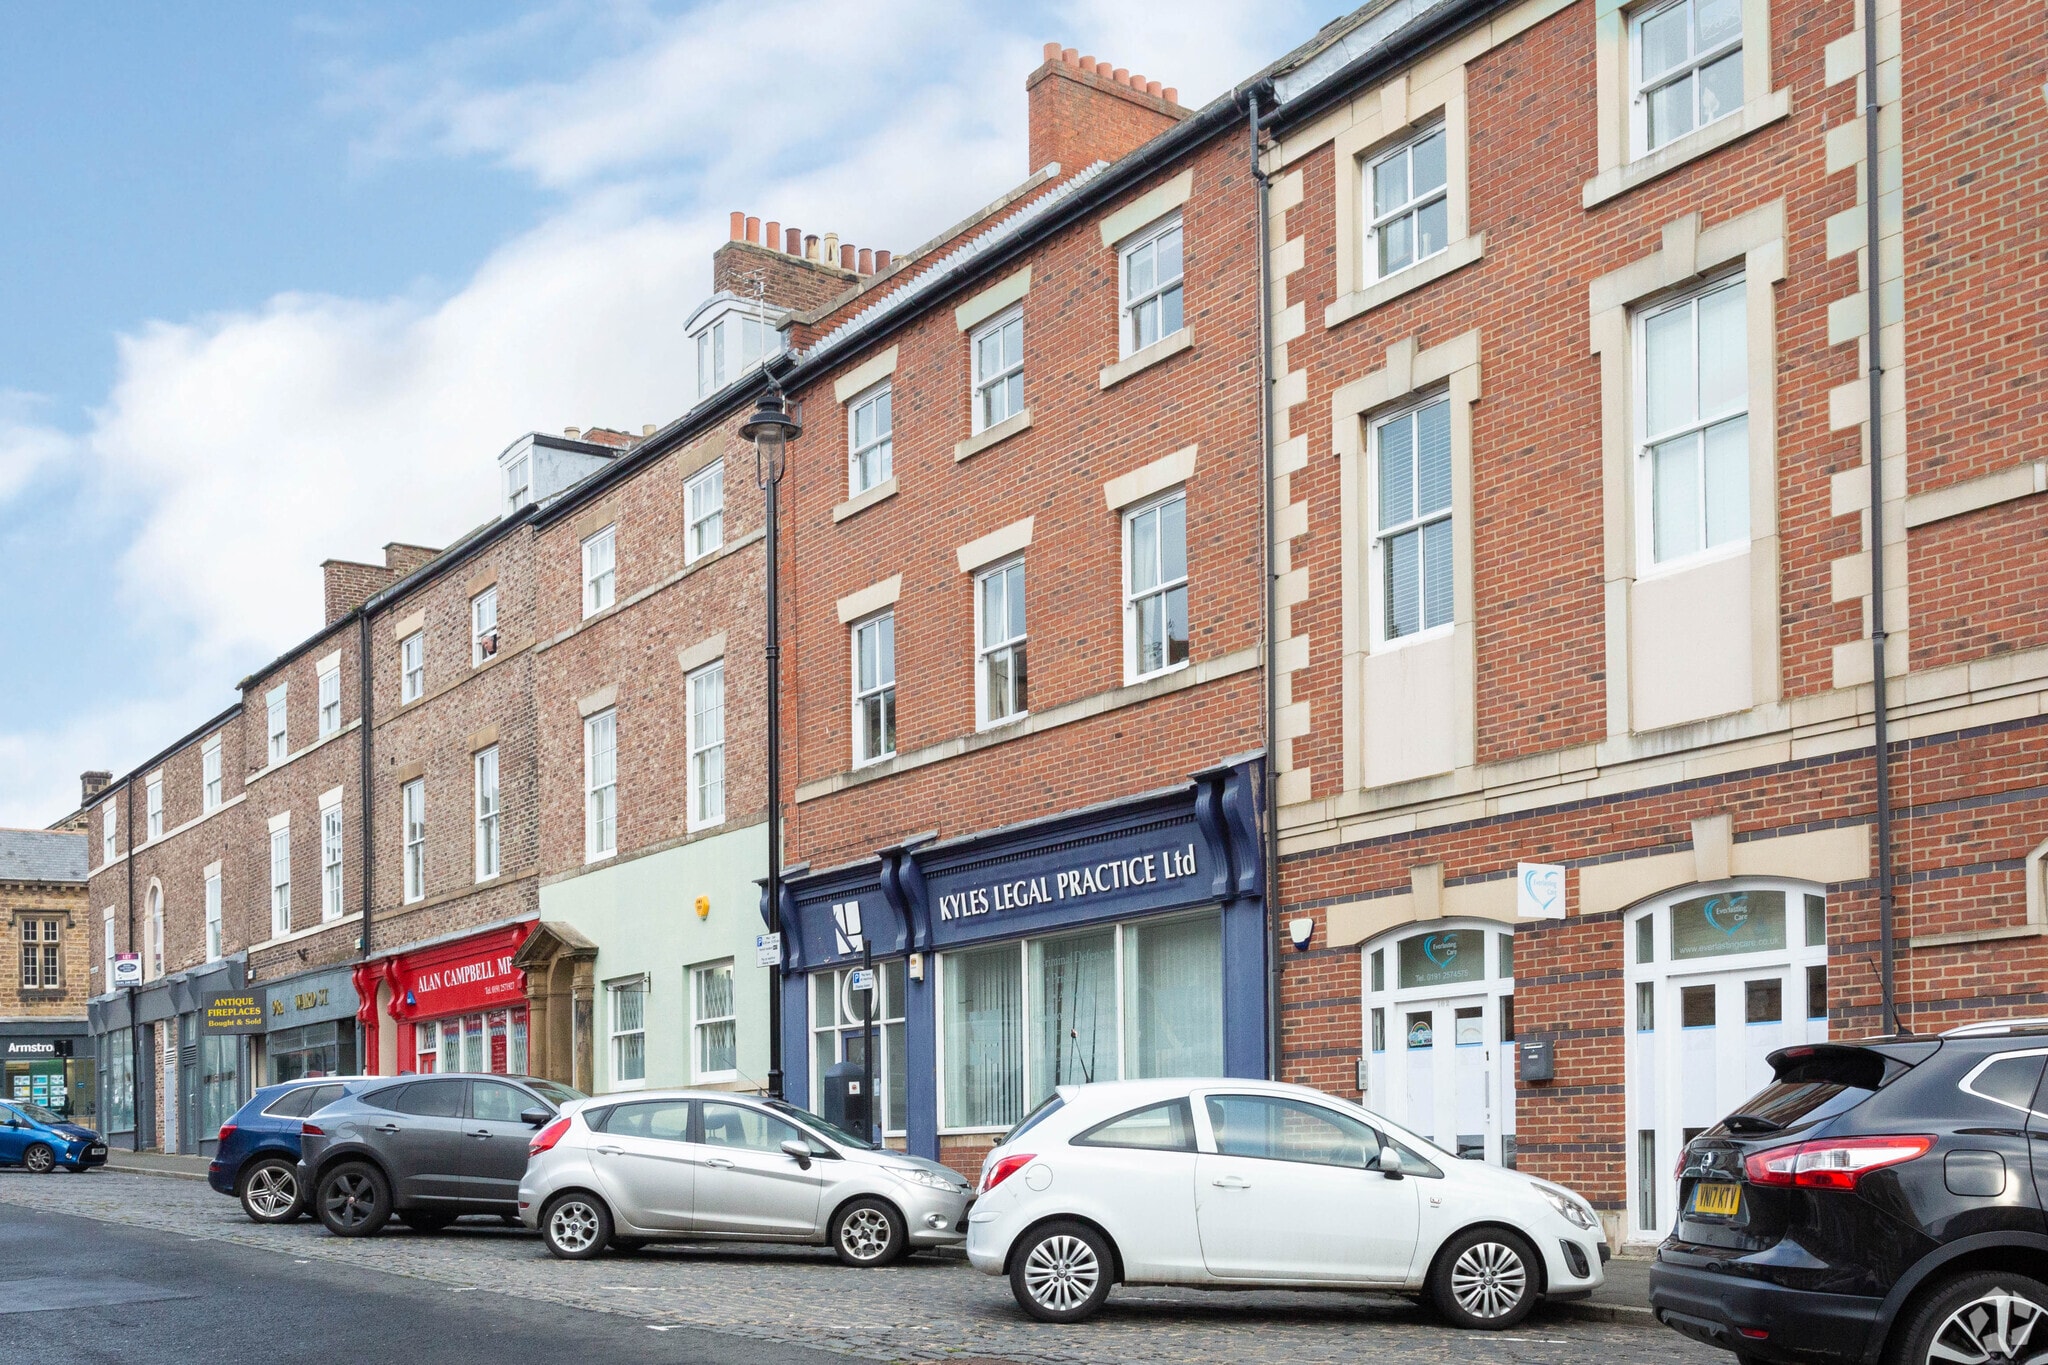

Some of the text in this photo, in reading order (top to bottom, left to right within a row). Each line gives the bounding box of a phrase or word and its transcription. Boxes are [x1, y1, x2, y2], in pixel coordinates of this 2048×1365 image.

[939, 843, 1197, 921] KYLES LEGAL PRACTICE Ltd
[1716, 905, 1748, 915] Everlasting
[1679, 938, 1780, 954] www.everlastingcare.co.uk
[418, 956, 512, 993] ALAN CAMPBELL MP
[214, 997, 254, 1007] ANTIQUE
[207, 1007, 261, 1017] FIREPLACES
[208, 1019, 234, 1028] Bought
[8, 1042, 55, 1053] Armstro
